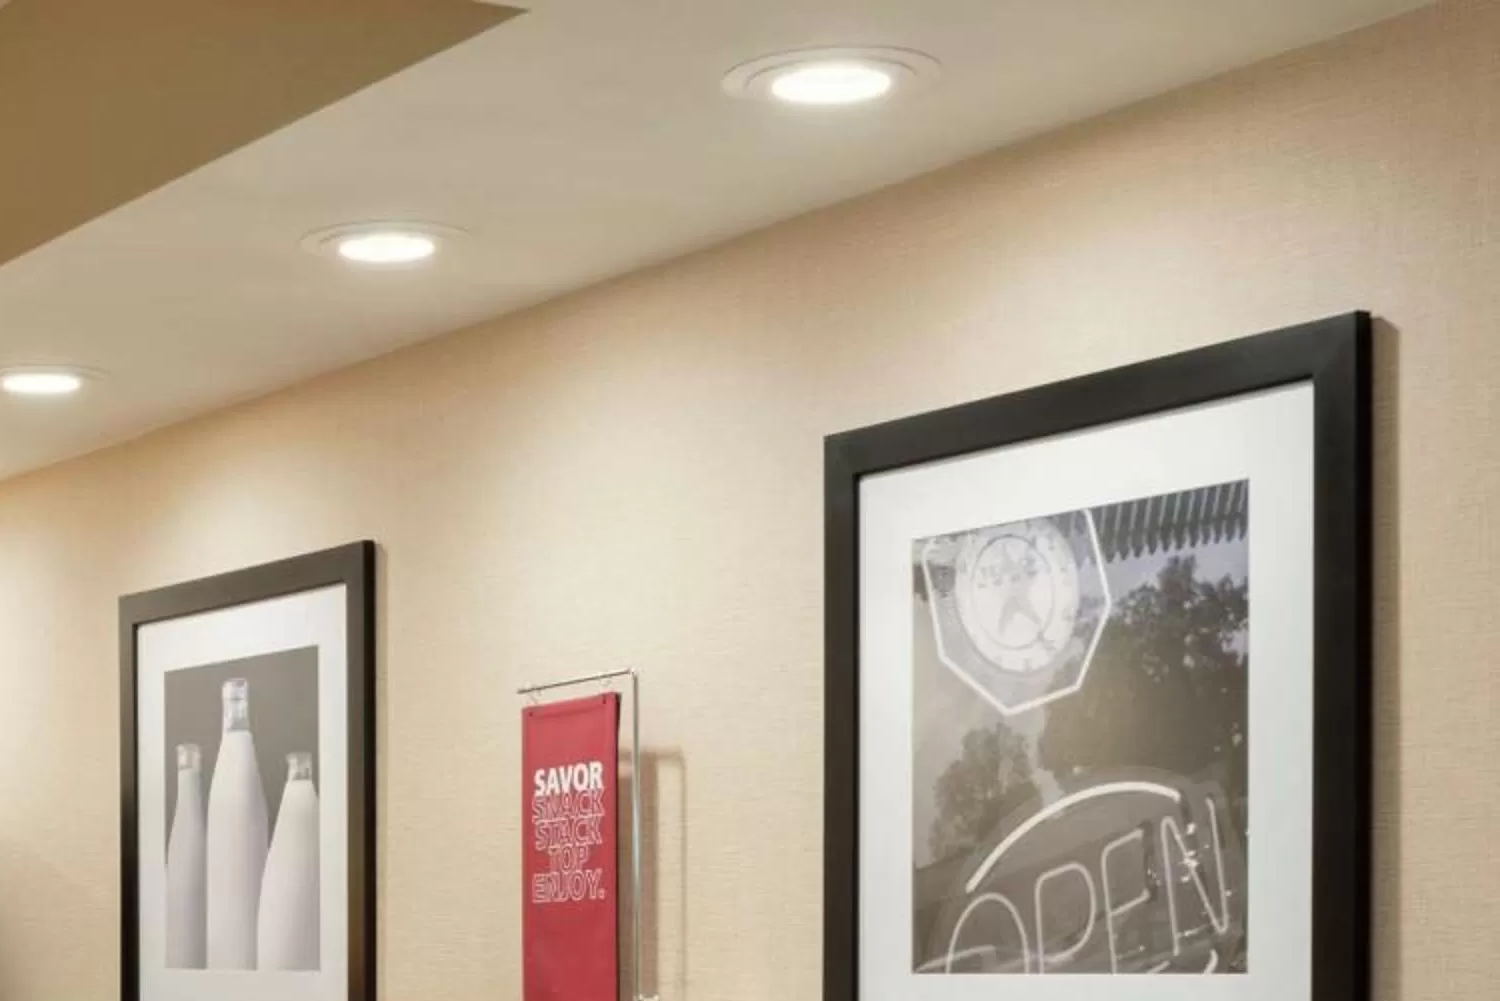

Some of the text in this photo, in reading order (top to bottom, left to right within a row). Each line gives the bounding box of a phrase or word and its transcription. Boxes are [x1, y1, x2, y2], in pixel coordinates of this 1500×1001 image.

[534, 761, 604, 797] SAVOR
[531, 788, 605, 822] SNACK
[535, 815, 603, 850] STACK
[531, 867, 605, 903] ENJOY.
